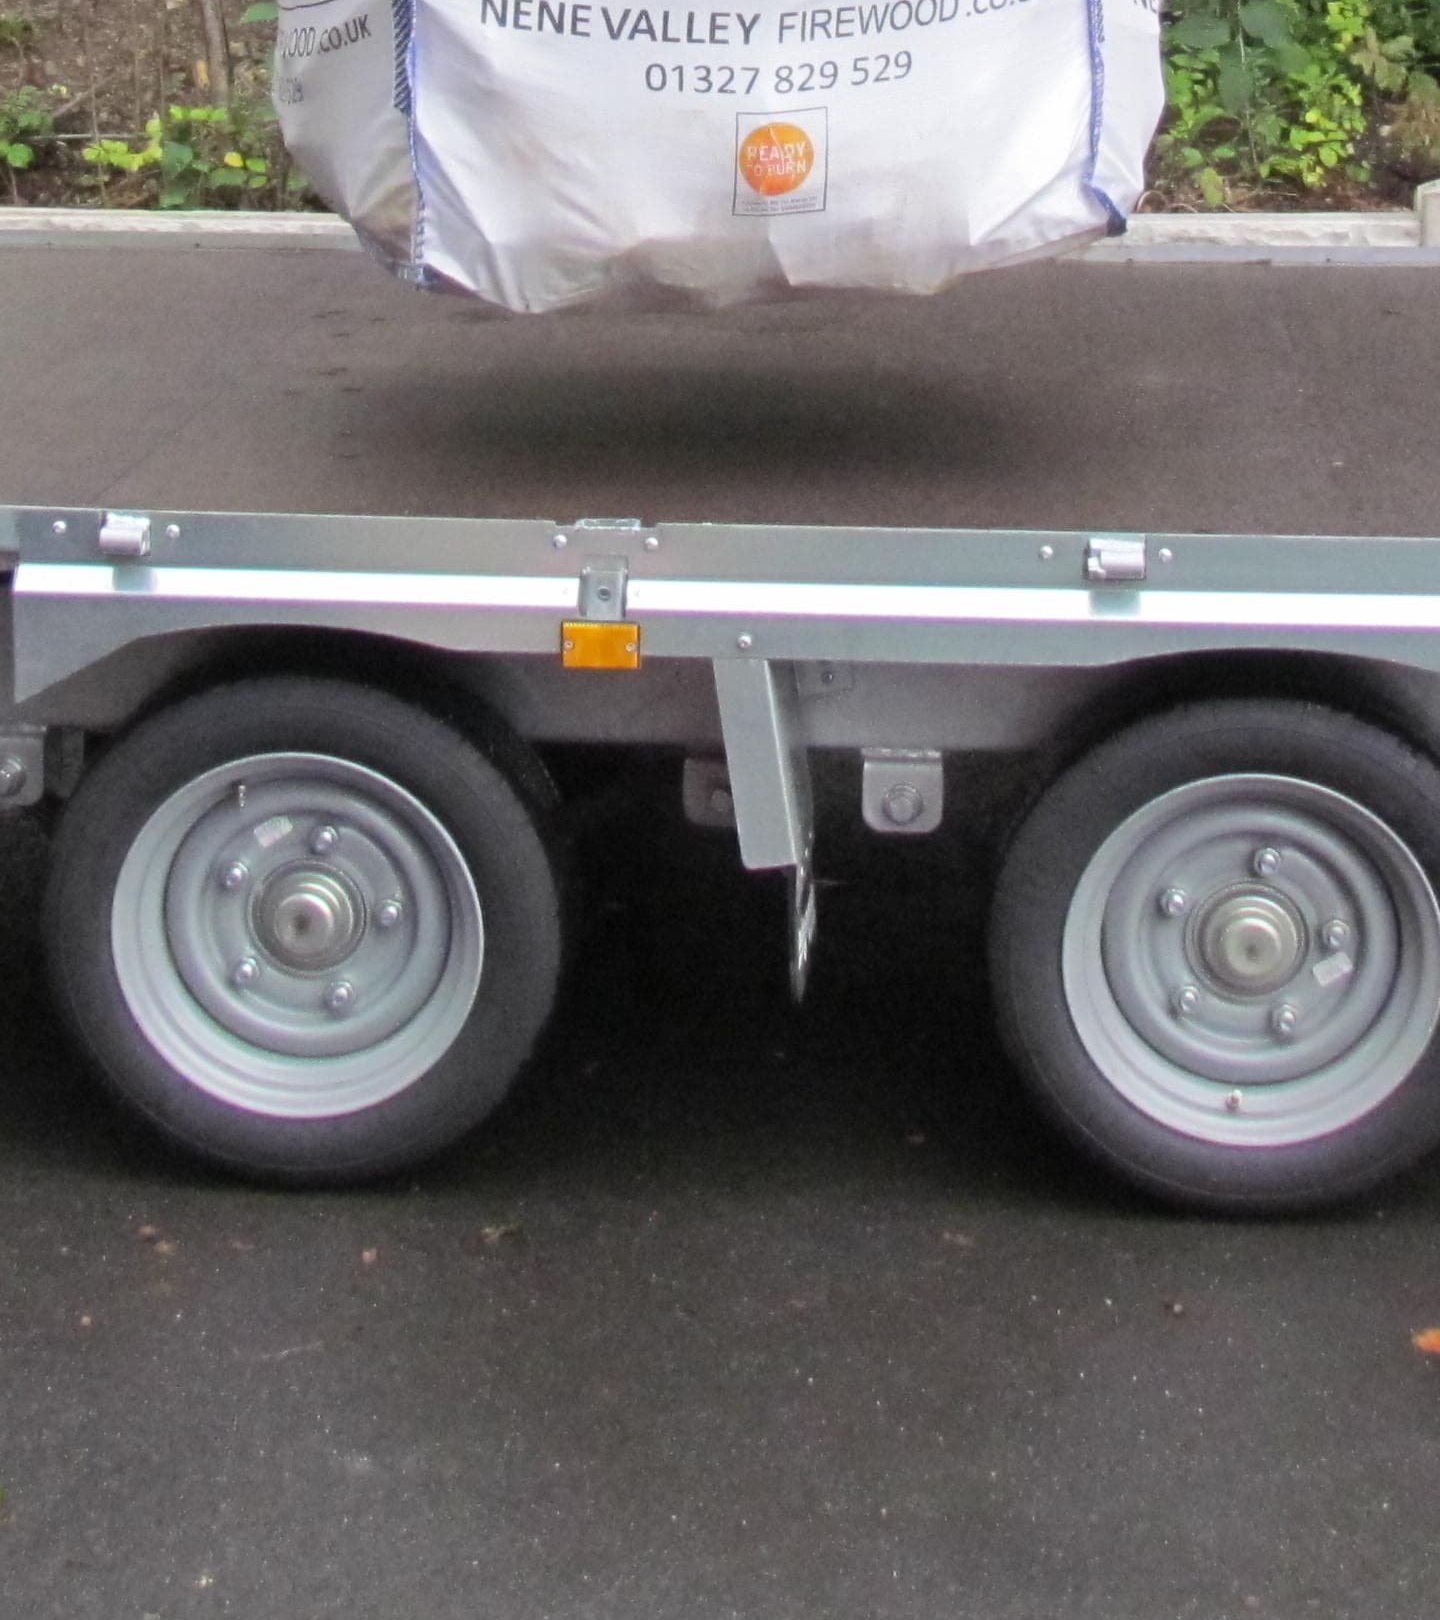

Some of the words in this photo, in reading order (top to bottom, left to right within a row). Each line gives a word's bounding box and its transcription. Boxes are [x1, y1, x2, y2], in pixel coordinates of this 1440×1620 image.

[600, 5, 761, 46] VALLEY
[645, 62, 760, 95] 01327
[773, 60, 839, 95] 829
[850, 49, 913, 87] 529
[747, 140, 806, 163] READY
[767, 159, 807, 176] BURN
